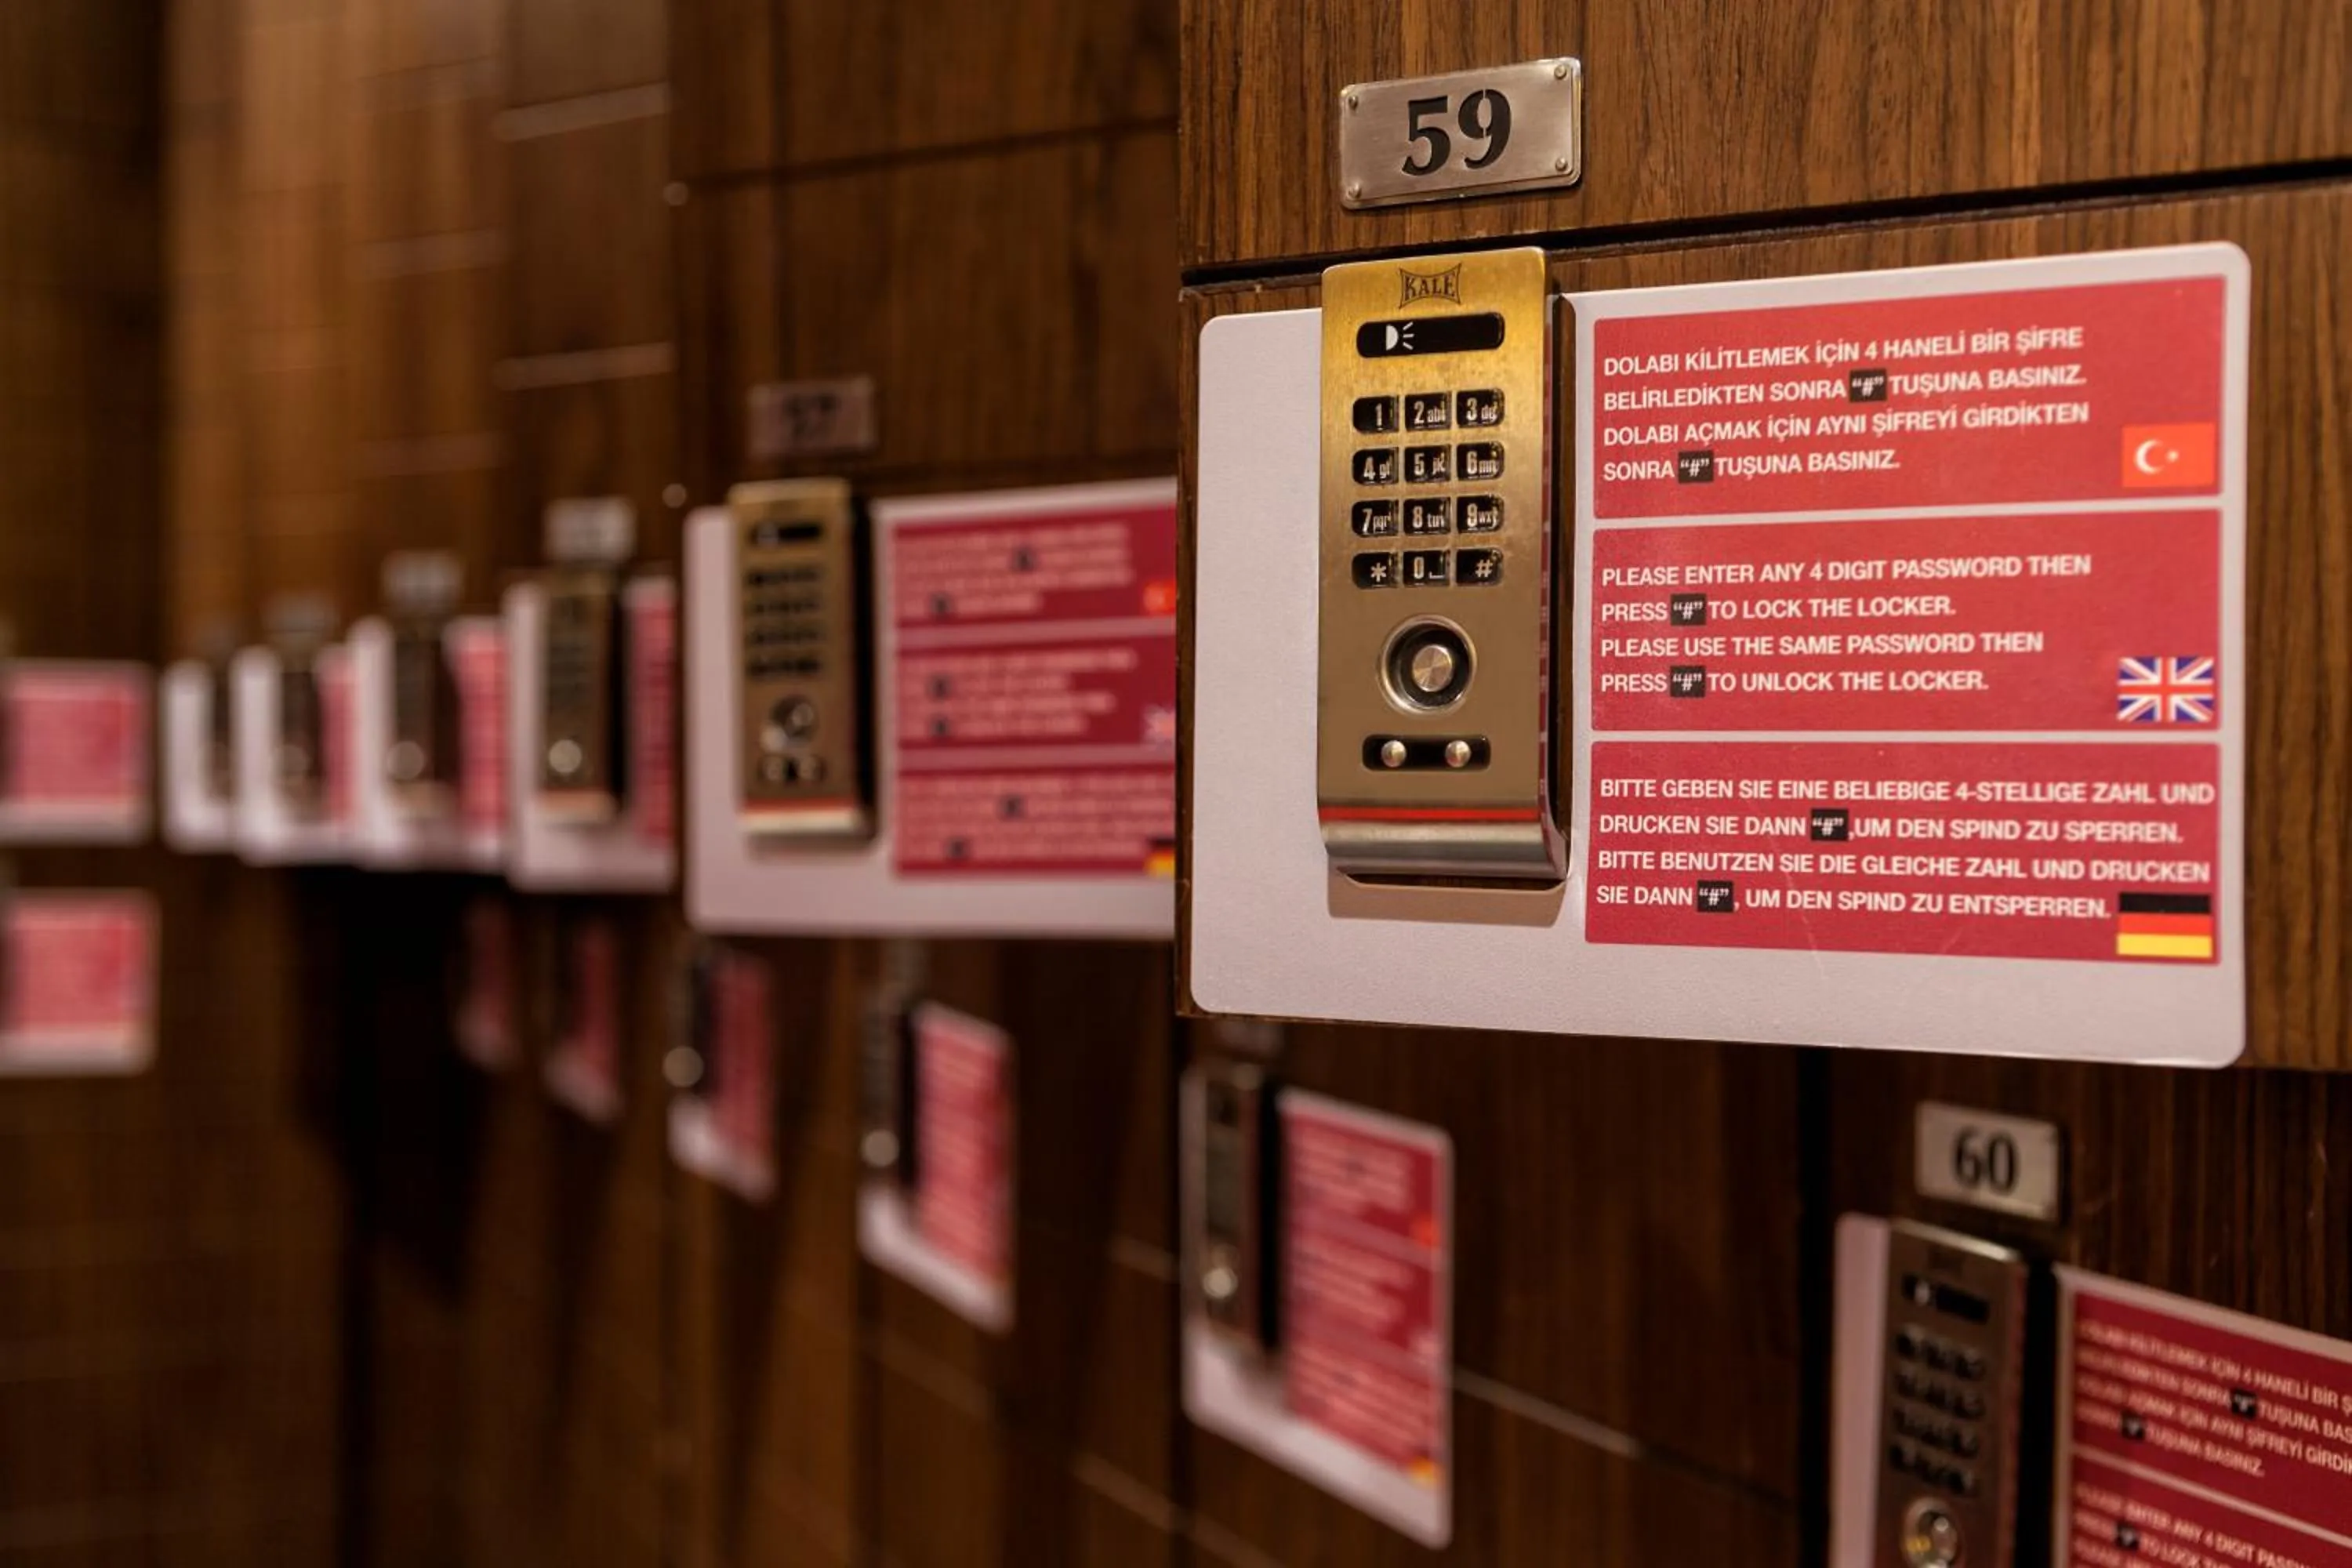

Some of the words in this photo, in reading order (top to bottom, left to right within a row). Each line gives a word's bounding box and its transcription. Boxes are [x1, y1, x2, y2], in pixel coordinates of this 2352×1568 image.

[1401, 88, 1512, 177] 59
[1404, 271, 1456, 301] KALE
[1604, 354, 1679, 376] DOLABI
[1686, 346, 1809, 372] KİLİTLEMEK
[1816, 339, 1860, 368] İÇİN
[1864, 340, 1878, 360] 4
[1883, 330, 1965, 359] HANELİ
[1971, 328, 2009, 354] BİR
[2016, 325, 2084, 356] ŞİFRE
[1604, 383, 1764, 412] BELİRLEDİKTEN
[1769, 379, 1846, 401] SONRA
[1889, 371, 1983, 398] TUŞUNA
[1988, 365, 2087, 390] BASINIZ.
[1375, 402, 1383, 427] 1
[1414, 401, 1425, 424] 2
[1465, 397, 1478, 421] 3
[1604, 424, 1679, 446] DOLABI
[1684, 419, 1762, 446] AÇMAK
[1767, 414, 1811, 442] İÇİN
[1816, 415, 1867, 435] AYNI
[1872, 404, 1958, 437] ŞİFREYİ
[1963, 401, 2090, 429] GİRDİKTEN
[1363, 457, 1376, 480] 4
[1414, 452, 1425, 475] 5
[1466, 451, 1478, 474] 6
[1603, 459, 1675, 481] SONRA
[1714, 454, 1802, 481] TUŞUNA
[1808, 449, 1900, 473] BASINIZ.
[1362, 508, 1373, 533] 7
[1412, 506, 1424, 528] 8
[1466, 503, 1479, 528] 9
[1475, 559, 1494, 578] #
[1602, 565, 1679, 586] PLEASE
[1686, 564, 1754, 585] ENTER
[1759, 562, 1806, 583] ANY
[1809, 563, 1824, 582] 4
[1828, 560, 1887, 582] DIGIT
[1892, 556, 2022, 580] PASSWORD
[2027, 554, 2092, 576] THEN
[1602, 601, 1668, 622] PRESS
[1708, 600, 1737, 619] TO
[1742, 598, 1803, 619] LOCK
[1808, 597, 1853, 618] THE
[1857, 595, 1957, 617] LOCKER.
[1601, 637, 1679, 657] PLEASE
[1685, 637, 1726, 657] USE
[1731, 636, 1774, 655] THE
[1779, 634, 1842, 655] SAME
[1847, 632, 1976, 655] PASSWORD
[1980, 631, 2045, 653] THEN
[1601, 673, 1668, 693] PRESS
[1707, 672, 1737, 692] TO
[1741, 671, 1834, 692] UNLOCK
[1838, 670, 1883, 691] THE
[1889, 670, 1990, 691] LOCKER.
[1600, 778, 1657, 798] BITTE
[1661, 779, 1733, 799] GEBEN
[1738, 779, 1773, 800] SIE
[1778, 779, 1829, 800] EINE
[1833, 780, 1951, 801] BELIEBIGE
[1955, 782, 2088, 804] 4-STELLIGE
[2092, 782, 2158, 804] ZAHL
[2160, 782, 2216, 805] UND
[1599, 814, 1700, 835] DRUCKEN
[1705, 815, 1740, 836] SIE
[1744, 815, 1806, 837] DANN
[1896, 818, 1944, 839] DEN
[1949, 818, 2021, 840] SPIND
[2025, 819, 2060, 841] ZU
[2063, 820, 2183, 844] SPERREN.
[1598, 850, 1655, 870] BITTE
[1660, 851, 1774, 872] BENUTZEN
[1779, 853, 1813, 873] SIE
[1819, 854, 1857, 874] DIE
[1861, 855, 1961, 877] GLEICHE
[1965, 857, 2028, 879] ZAHL
[2032, 858, 2085, 880] UND
[2089, 859, 2211, 884] DRUCKEN
[1596, 884, 1631, 905] SIE
[1633, 886, 1693, 906] DANN
[1744, 888, 1781, 909] UM
[1786, 889, 1832, 910] DEN
[1837, 890, 1907, 913] SPIND
[1911, 892, 1944, 913] ZU
[1948, 893, 2112, 918] ENTSPERREN.
[1953, 1131, 2019, 1195] 60
[2253, 1368, 2309, 1401] HANELİ
[2311, 1385, 2339, 1410] BİR
[2258, 1399, 2321, 1435] TUŞUNA
